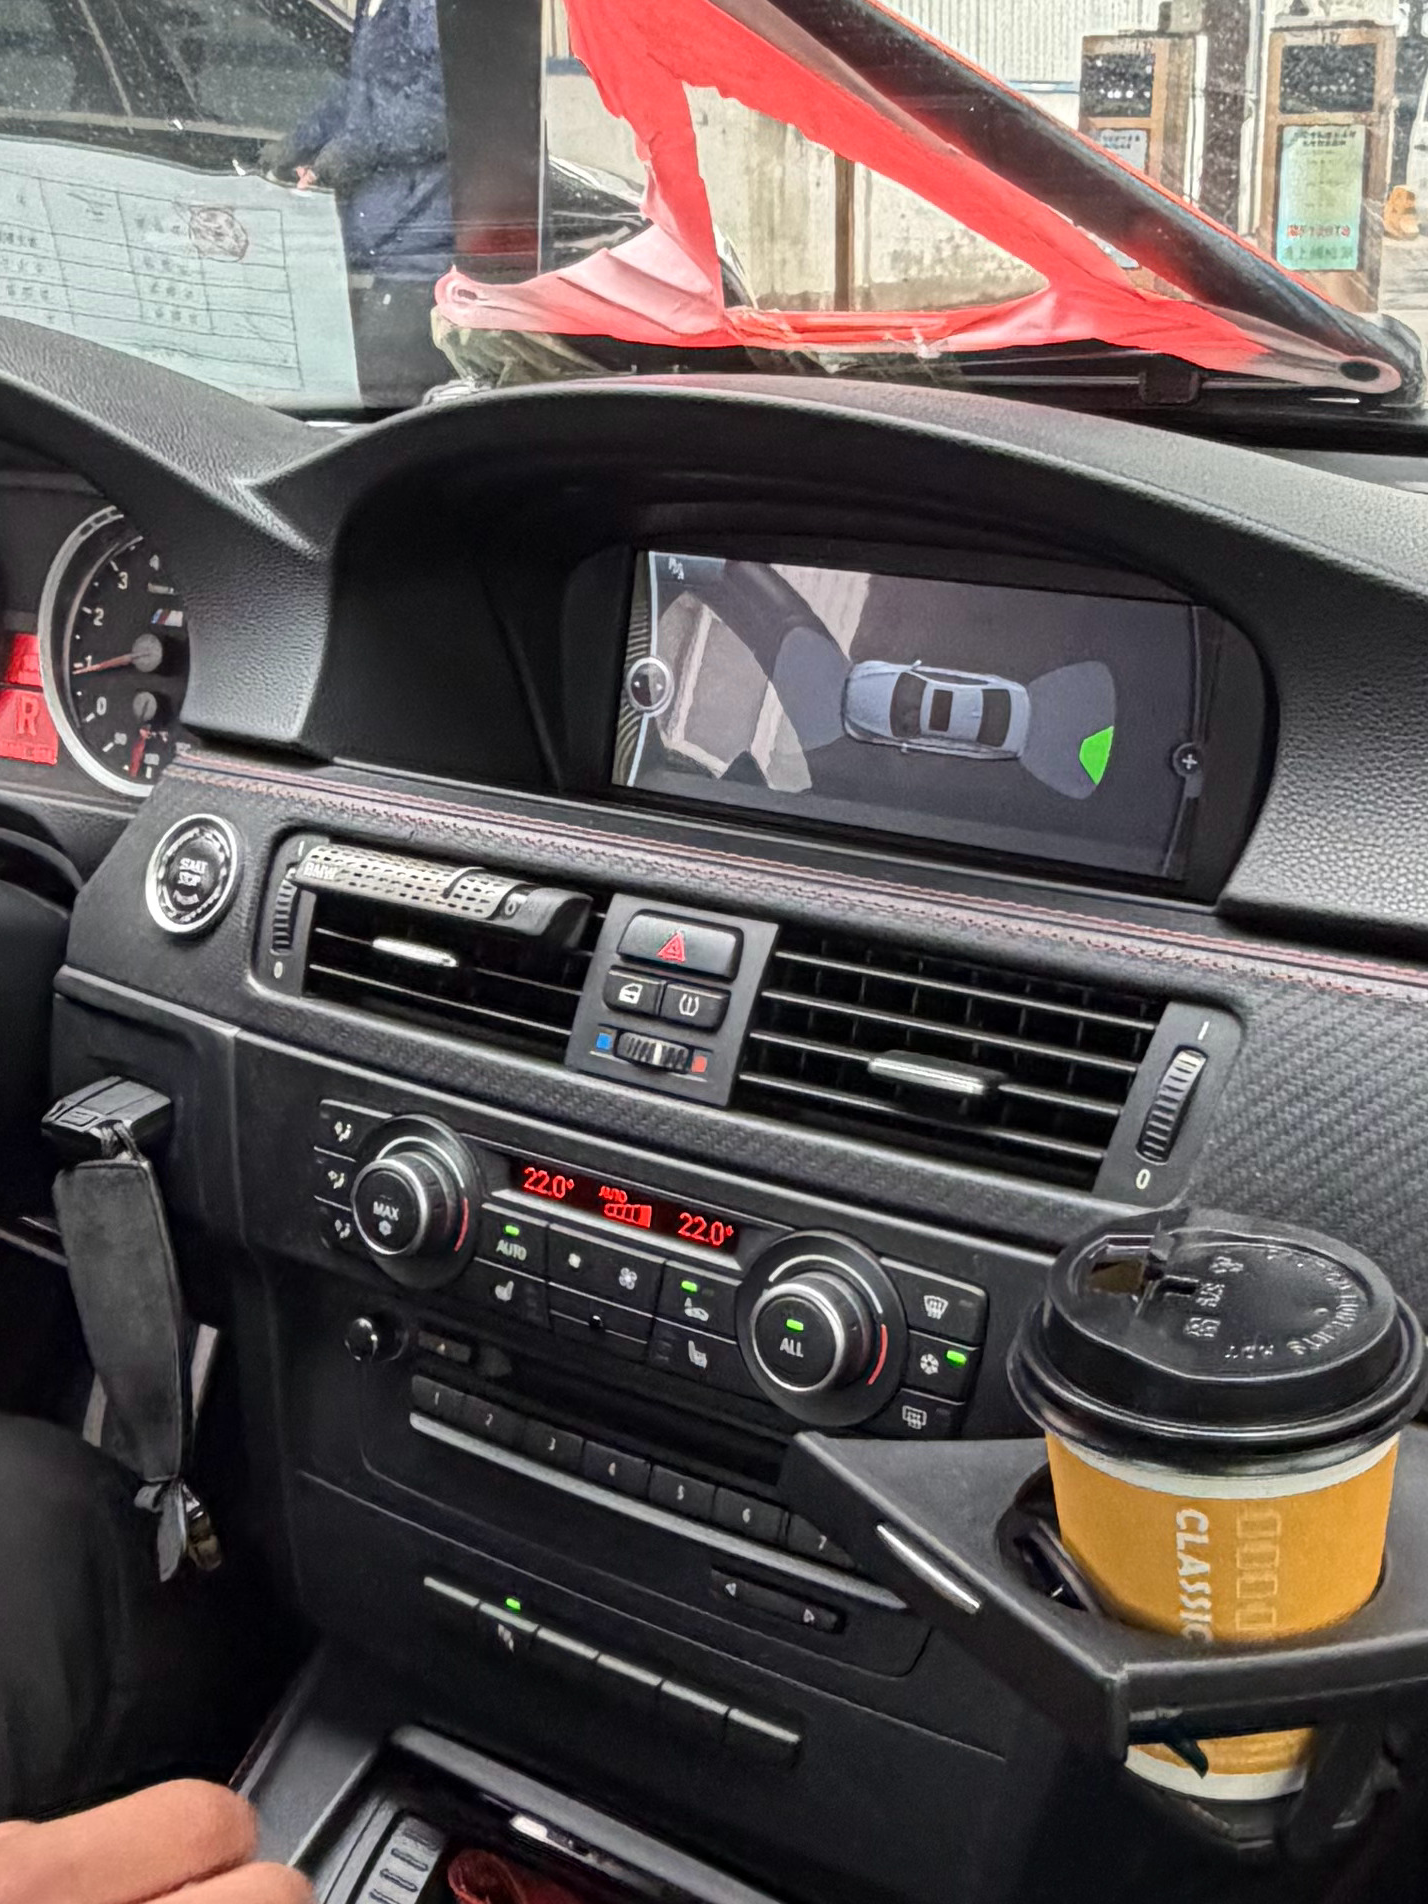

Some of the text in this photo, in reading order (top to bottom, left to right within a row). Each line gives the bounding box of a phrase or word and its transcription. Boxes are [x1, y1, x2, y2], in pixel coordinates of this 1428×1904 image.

[118, 571, 129, 590] 3
[93, 607, 105, 626] 2
[96, 696, 107, 715] 0
[18, 695, 39, 736] R
[372, 1200, 401, 1222] MAX
[496, 1238, 528, 1261] AUTO
[779, 1337, 805, 1358] ALL
[434, 1390, 440, 1405] 1
[548, 1437, 557, 1452] 3
[741, 1507, 751, 1524] 6
[817, 1534, 828, 1551] 7
[1175, 1507, 1215, 1643] CLASSIC
